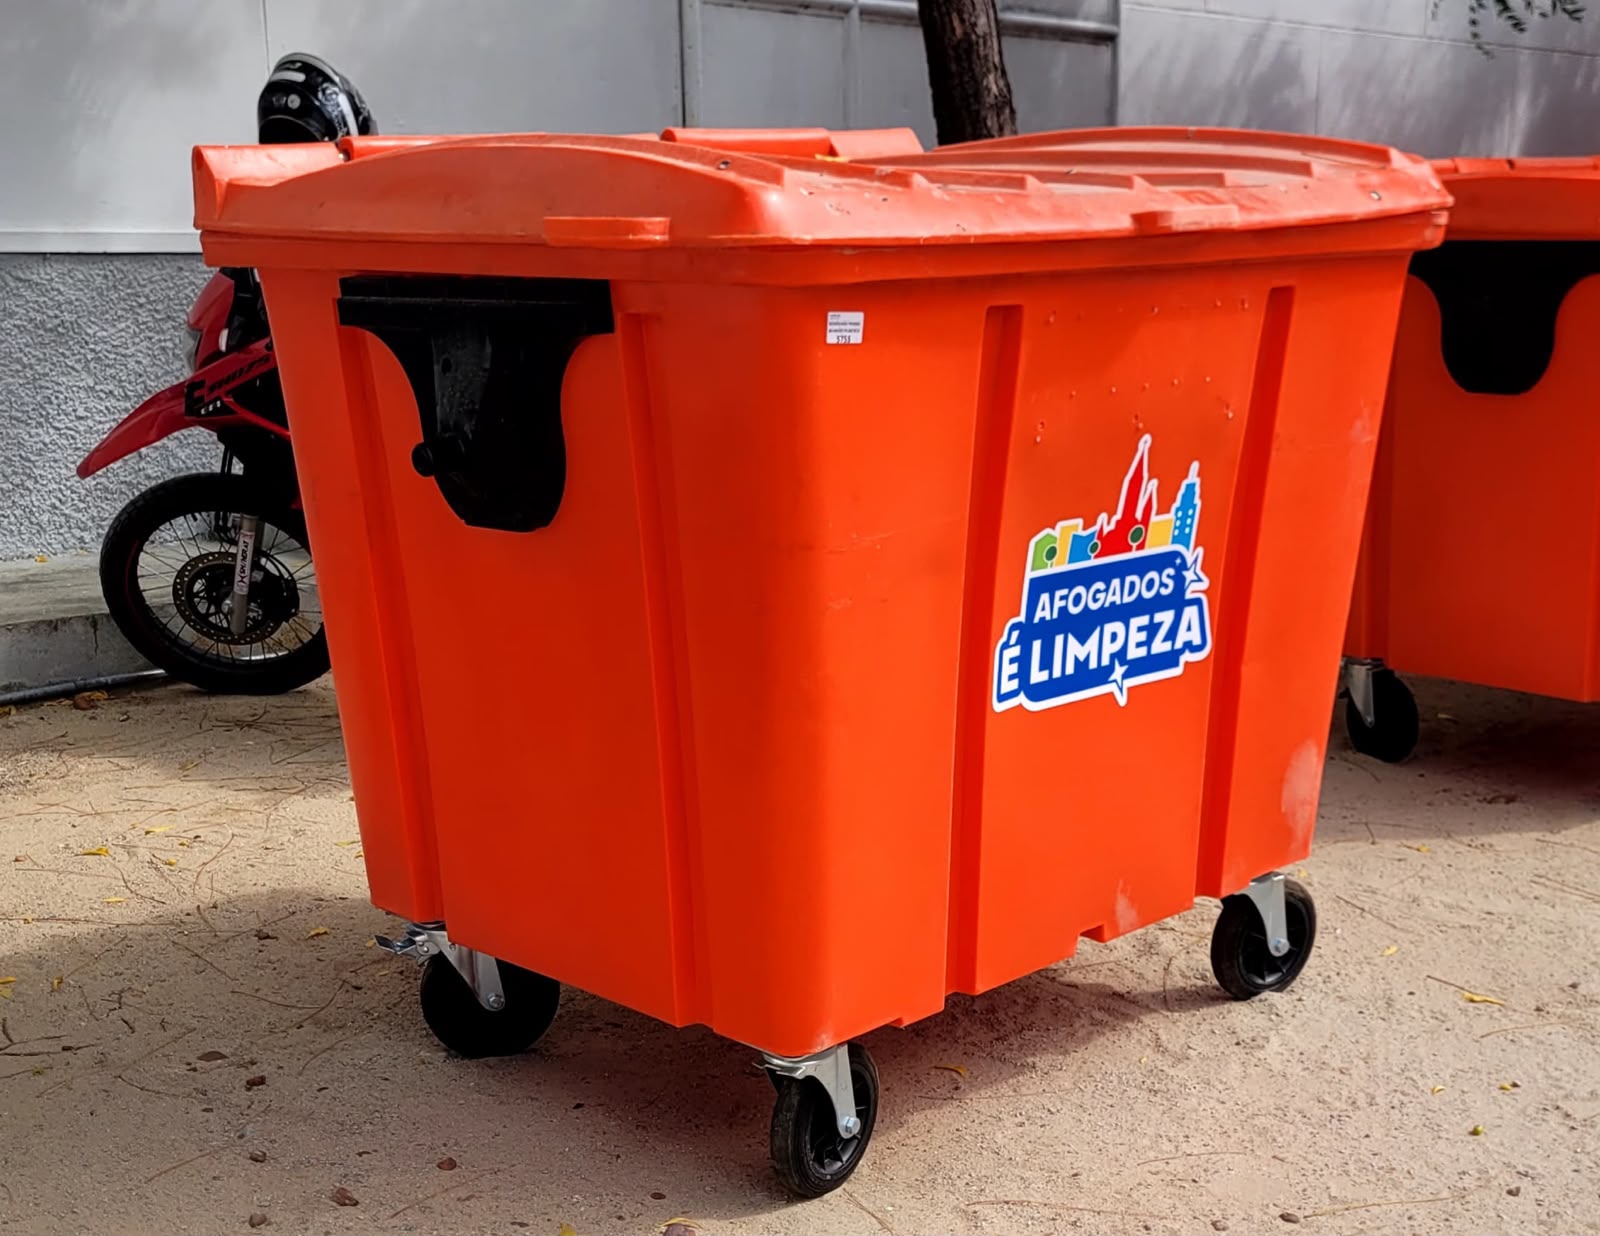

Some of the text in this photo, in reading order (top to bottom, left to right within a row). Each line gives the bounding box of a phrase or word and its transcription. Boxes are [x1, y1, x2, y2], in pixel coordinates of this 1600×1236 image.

[1033, 567, 1176, 624] AFOGADOS
[1000, 605, 1202, 695] É LIMPEZA
